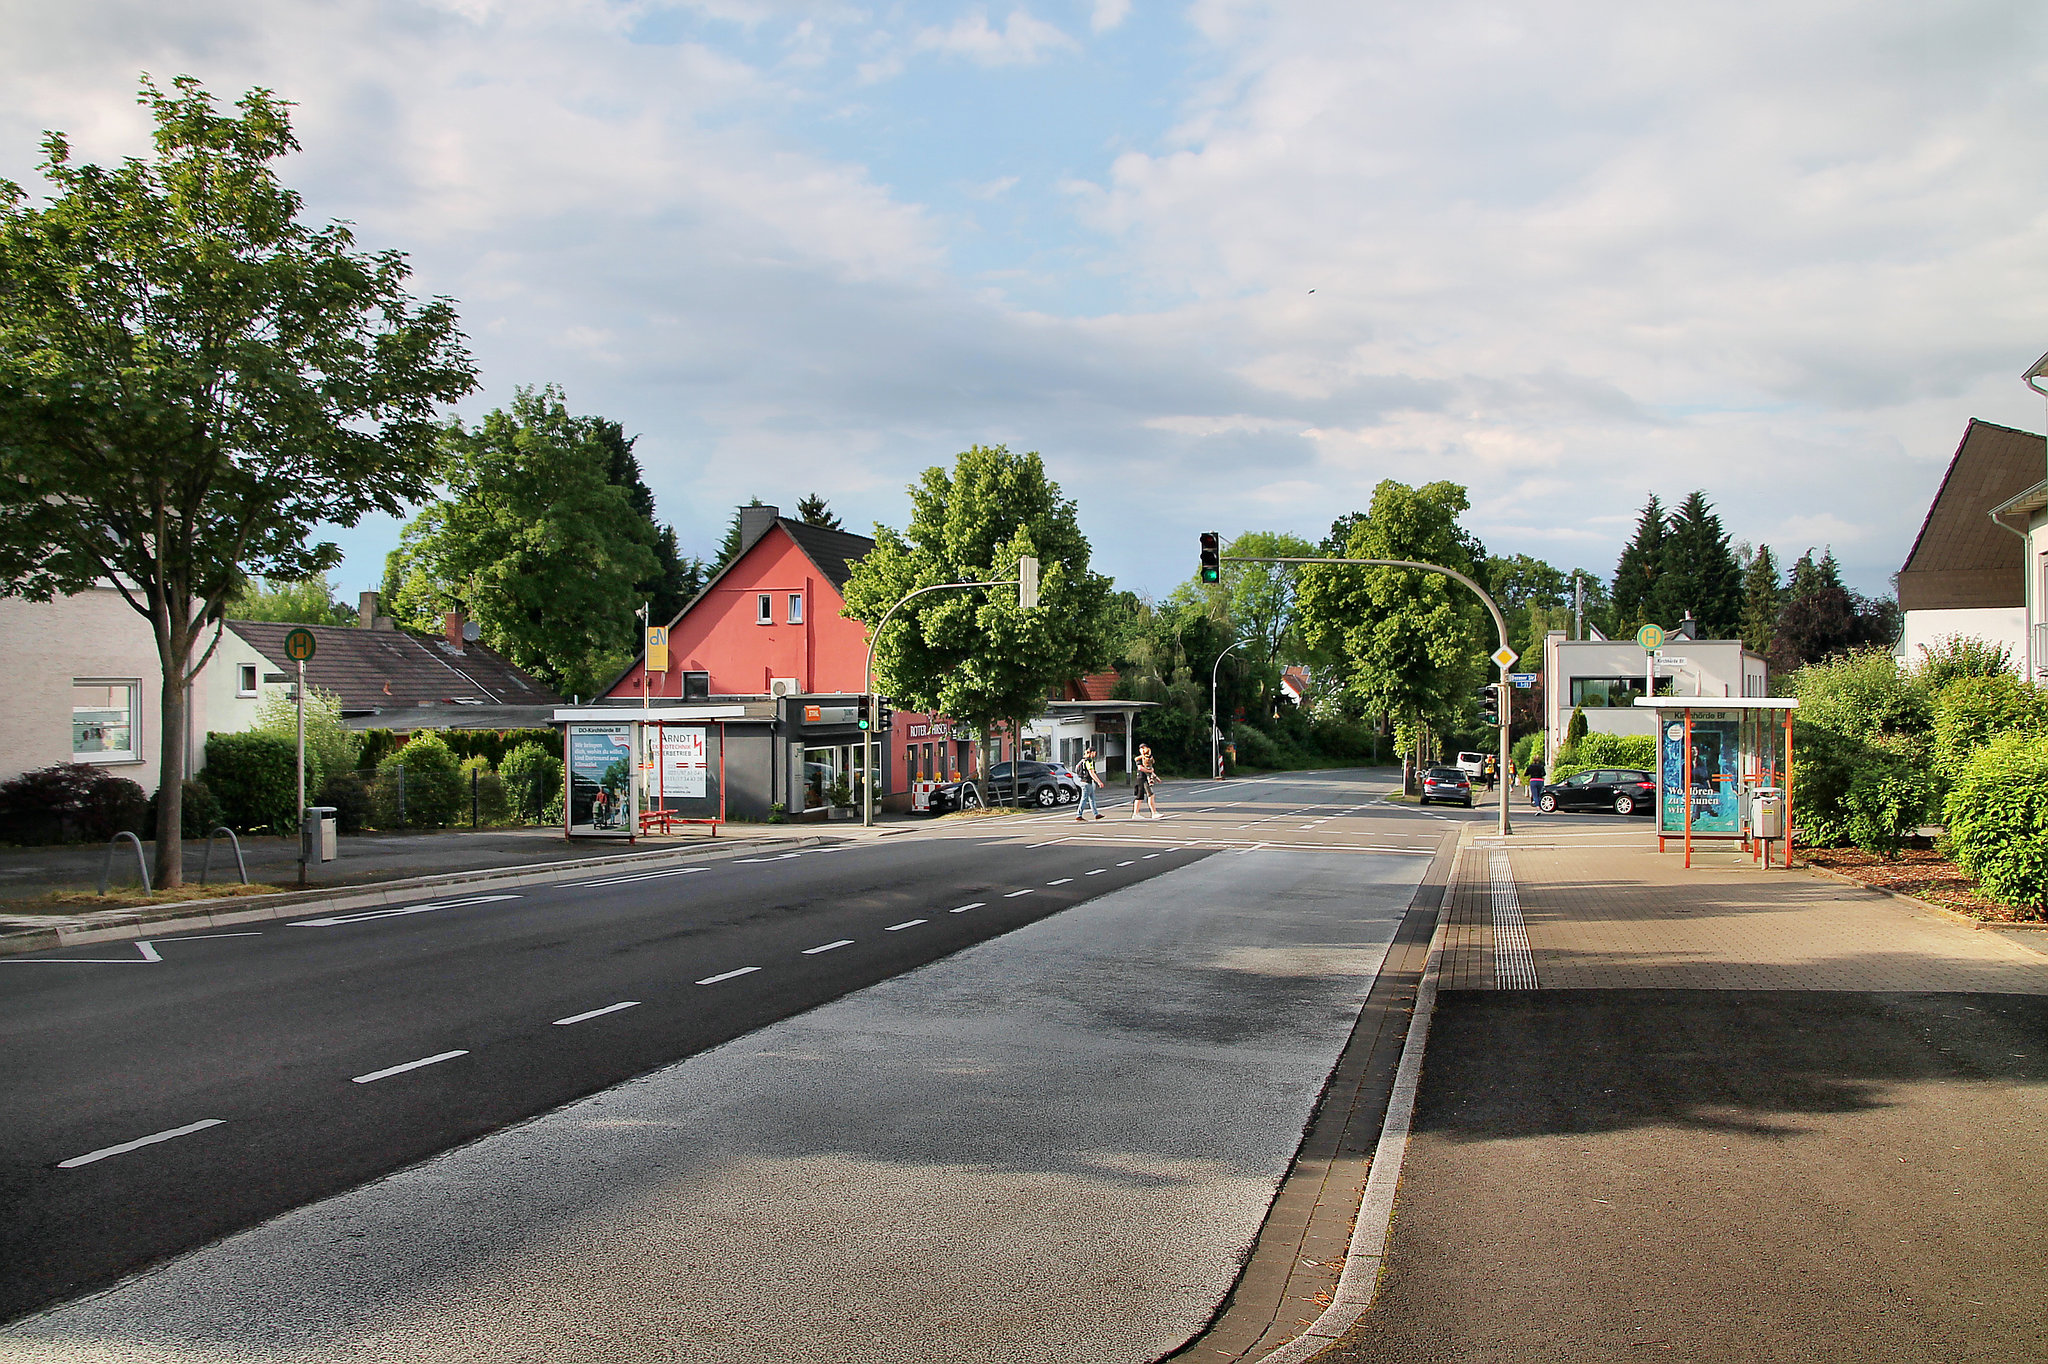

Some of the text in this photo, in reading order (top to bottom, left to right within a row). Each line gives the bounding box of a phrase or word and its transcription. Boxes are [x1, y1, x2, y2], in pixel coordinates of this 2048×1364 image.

[1646, 630, 1657, 645] H
[294, 635, 306, 656] H
[1717, 711, 1726, 719] Bf
[910, 724, 927, 737] ROTER
[931, 723, 948, 735] HIRSCH
[1668, 786, 1683, 795] Wo
[1681, 796, 1719, 805] Saunen
